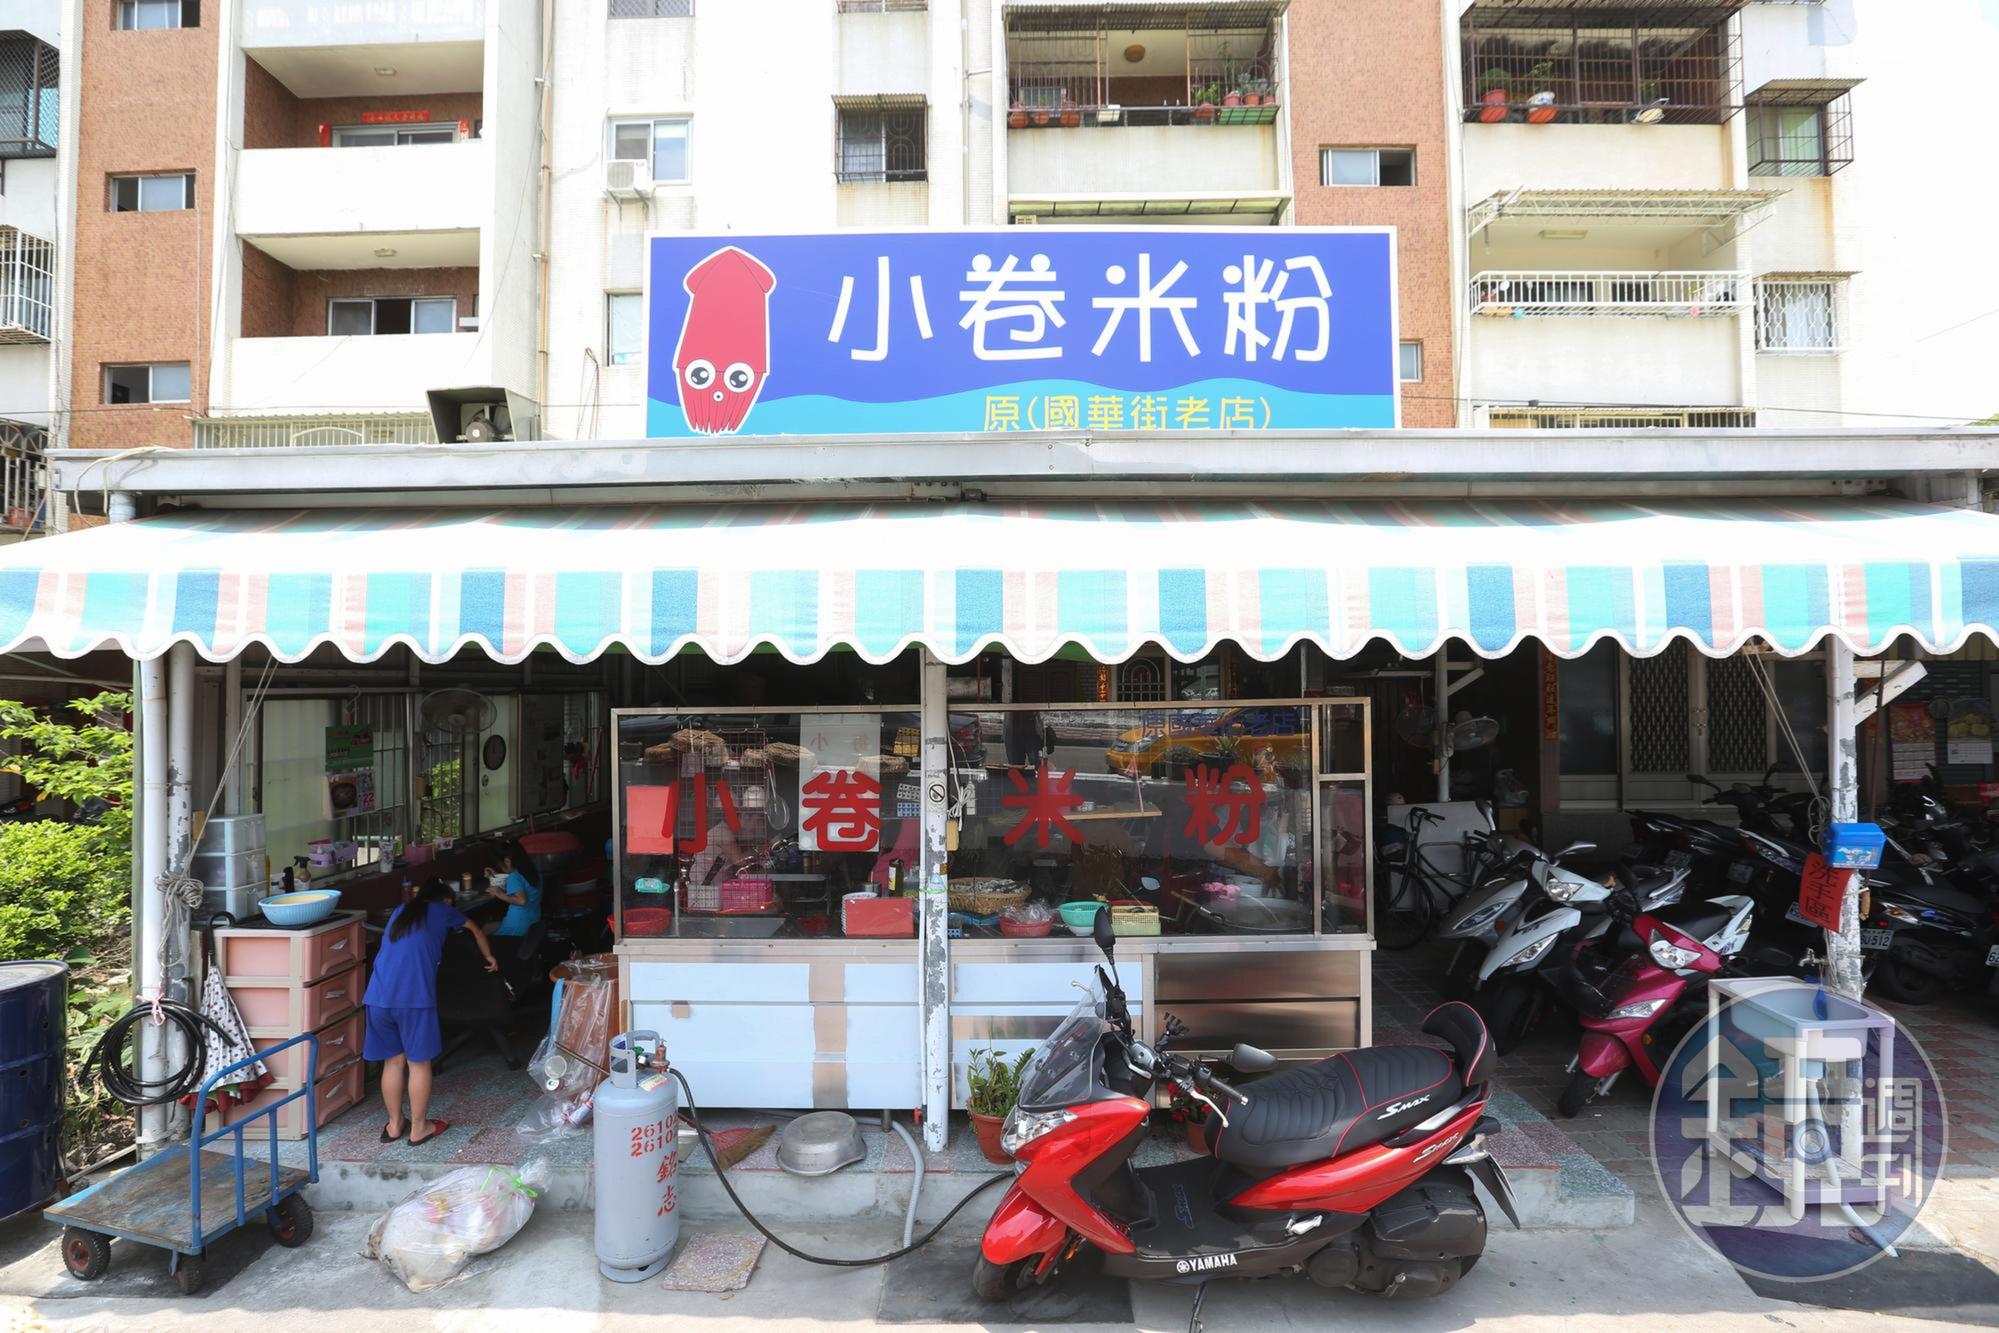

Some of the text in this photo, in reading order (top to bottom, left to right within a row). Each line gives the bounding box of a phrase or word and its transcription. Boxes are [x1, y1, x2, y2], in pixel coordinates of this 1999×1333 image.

[827, 253, 1333, 363] 小卷米粉
[661, 765, 1267, 853] 小卷米粉
[1189, 1253, 1238, 1271] YAMAHA
